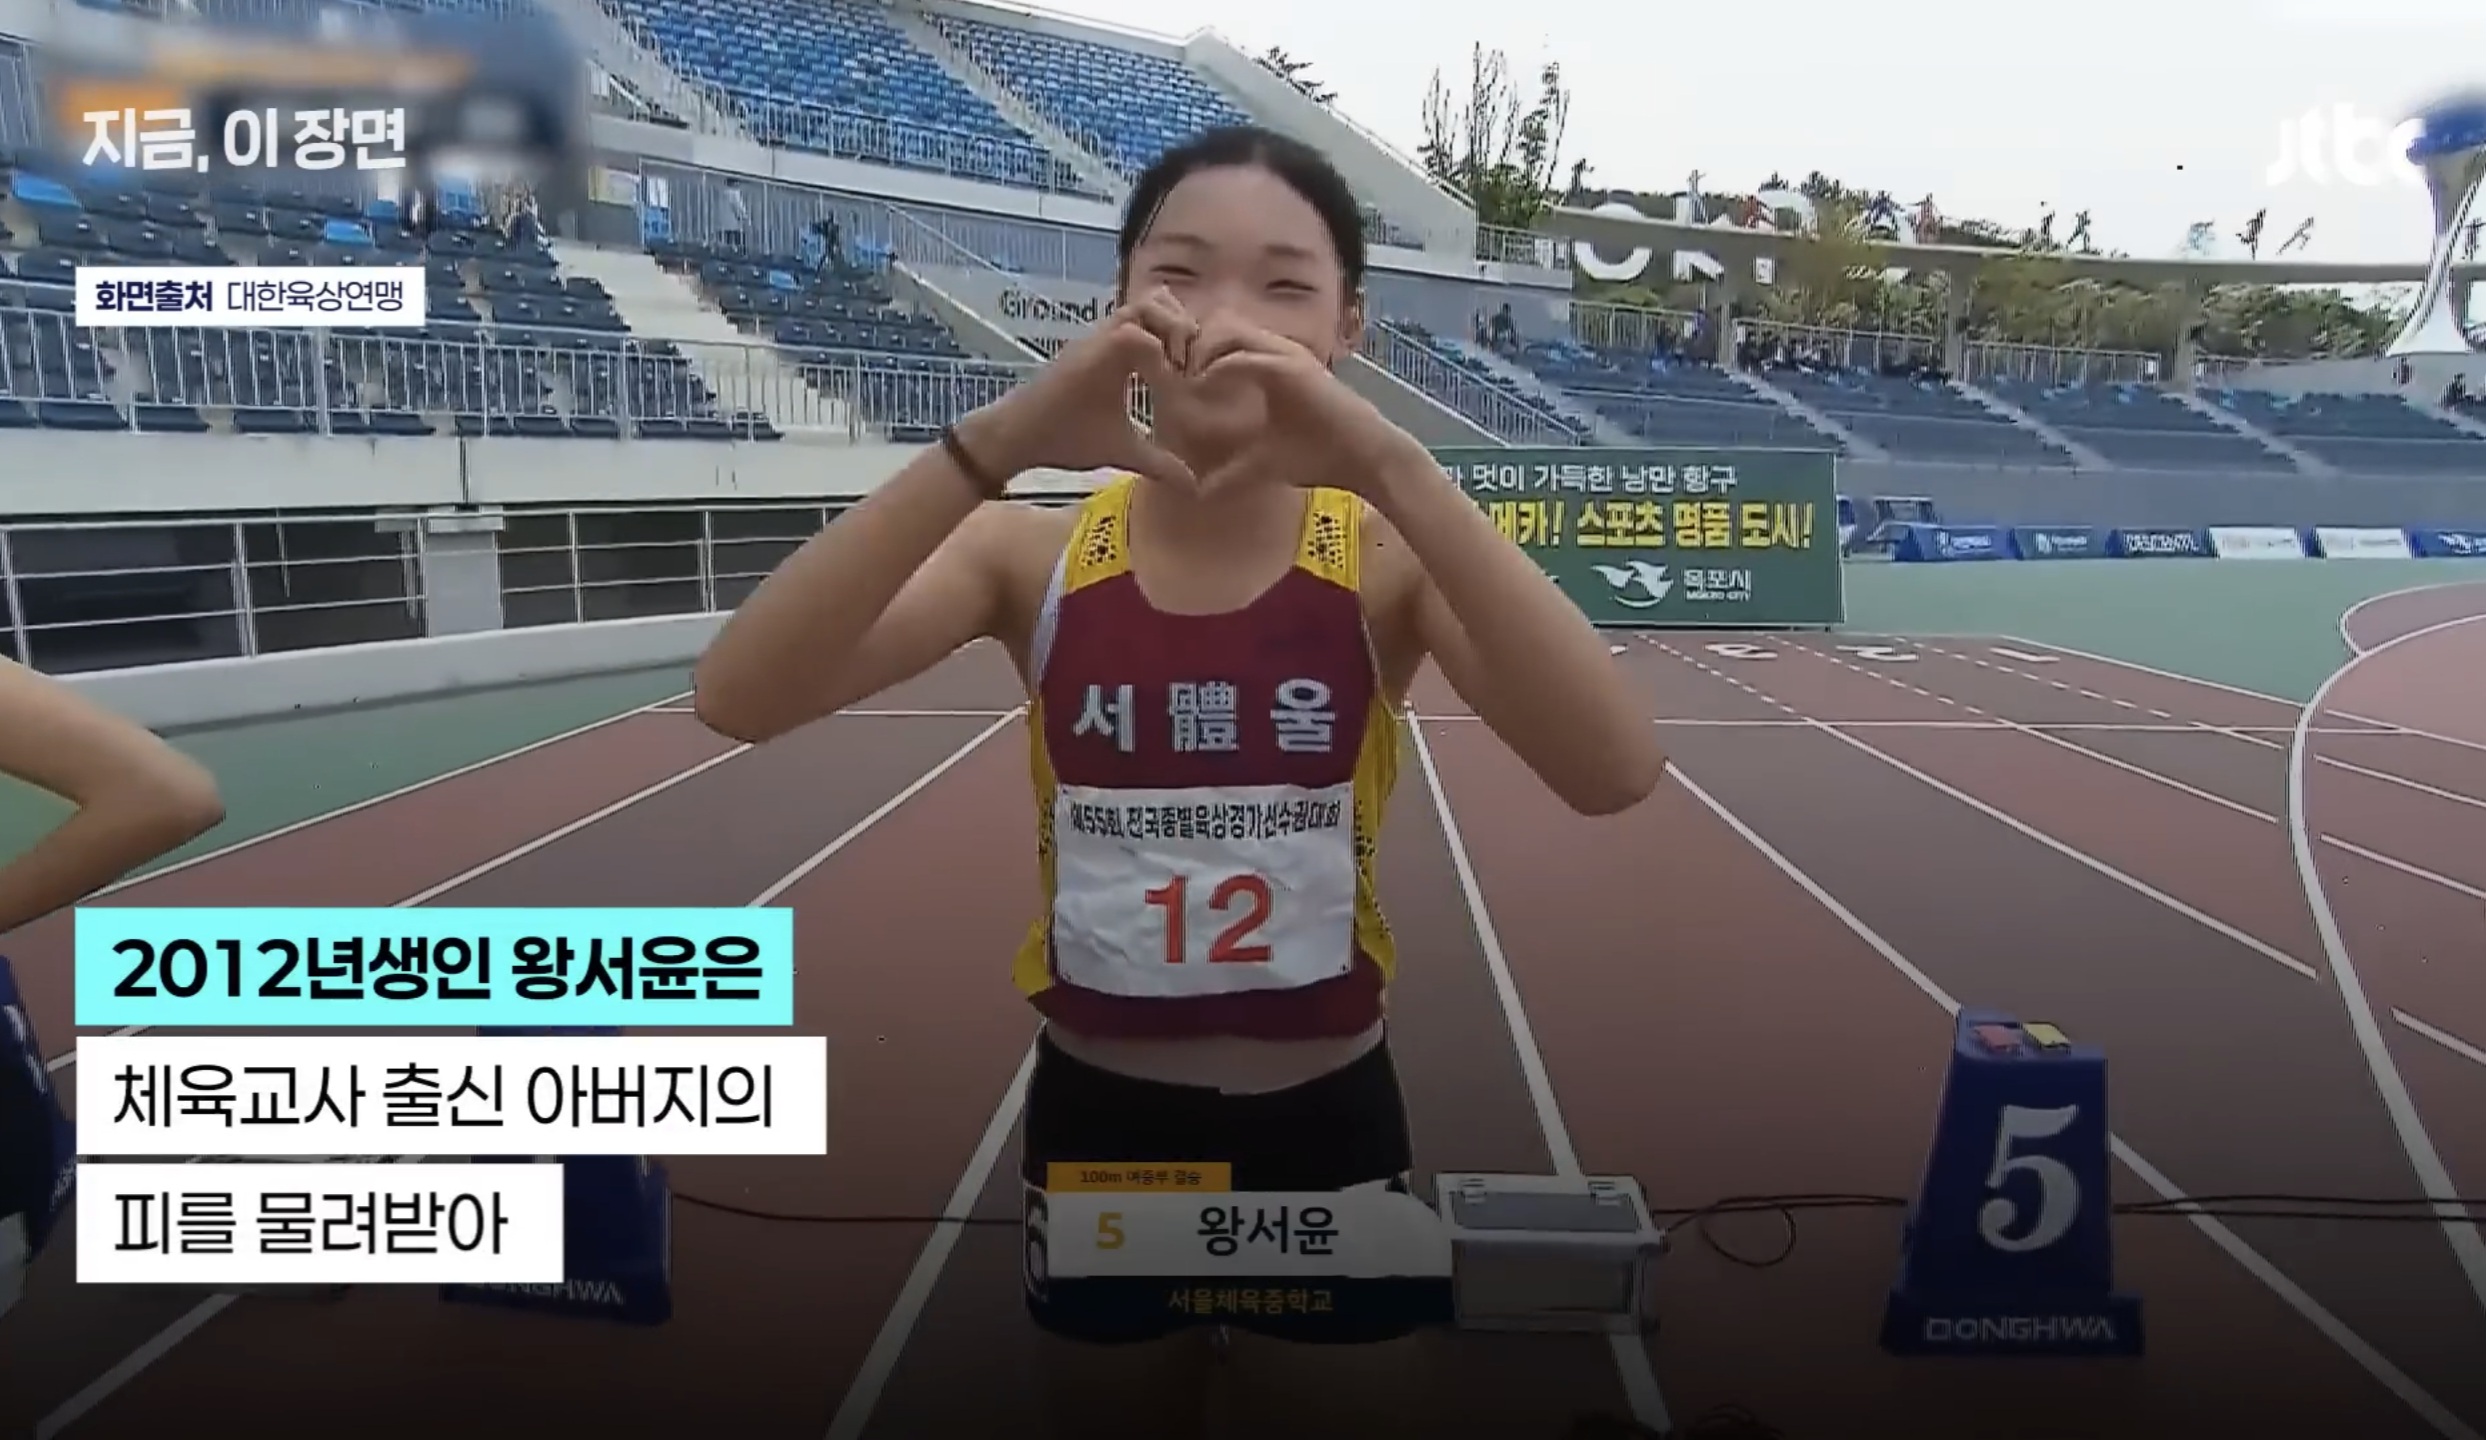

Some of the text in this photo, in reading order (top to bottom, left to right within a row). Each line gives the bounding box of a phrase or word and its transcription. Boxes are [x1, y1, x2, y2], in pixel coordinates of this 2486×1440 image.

[1473, 464, 1524, 492] 멋이
[1534, 464, 1613, 493] 가득한
[1683, 465, 1737, 494] 항구
[1577, 501, 1666, 546] 스포츠
[1673, 502, 1730, 547] 명품
[1741, 502, 1813, 549] 도시!
[1683, 569, 1752, 592] 목포시
[1073, 684, 1134, 752] 서
[1270, 679, 1336, 753] 울
[1145, 875, 1274, 964] 12
[1977, 1103, 2082, 1253] 5
[1923, 1316, 2116, 1342] DONGHWA
